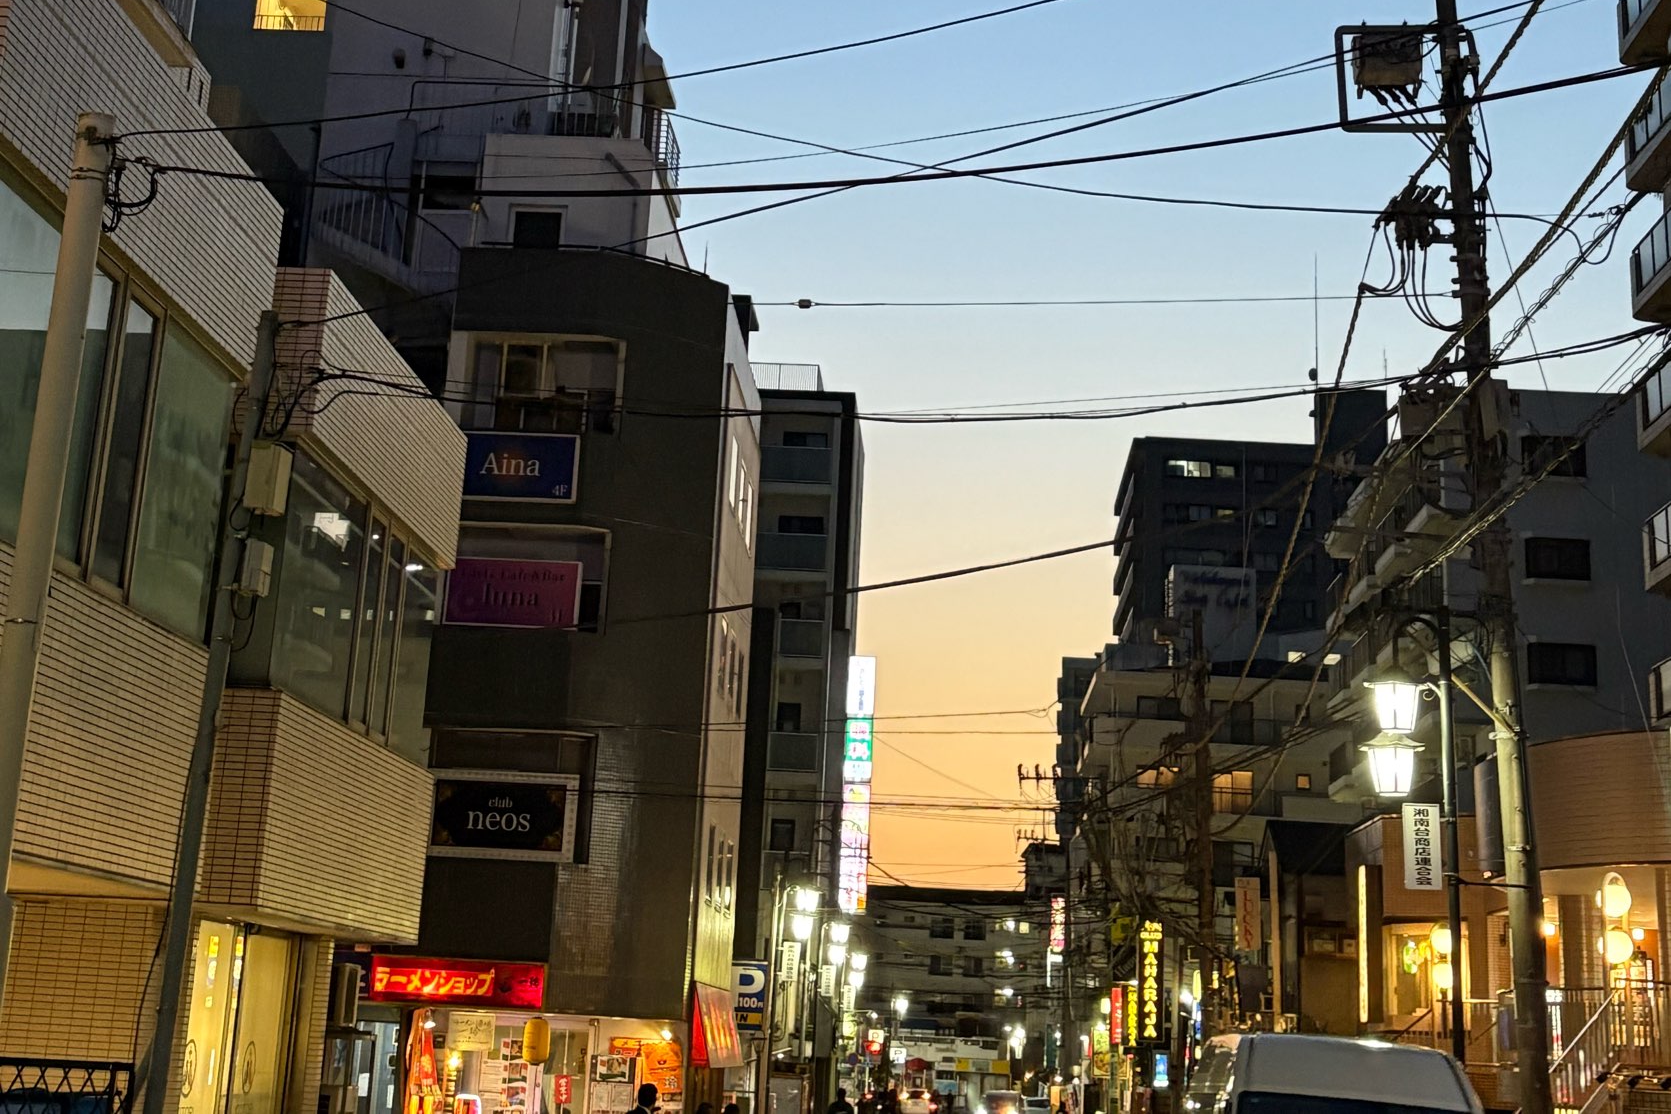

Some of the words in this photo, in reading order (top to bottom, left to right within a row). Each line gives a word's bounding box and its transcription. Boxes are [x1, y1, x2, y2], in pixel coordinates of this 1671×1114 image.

[480, 452, 541, 477] Aina
[552, 484, 568, 497] 4F
[488, 796, 513, 808] club
[467, 810, 531, 832] neos
[1413, 808, 1432, 886] 湘南台商店連合会
[375, 966, 495, 996] ラーメンショップ
[732, 967, 765, 1007] P
[1143, 941, 1159, 1038] MAHARAJA
